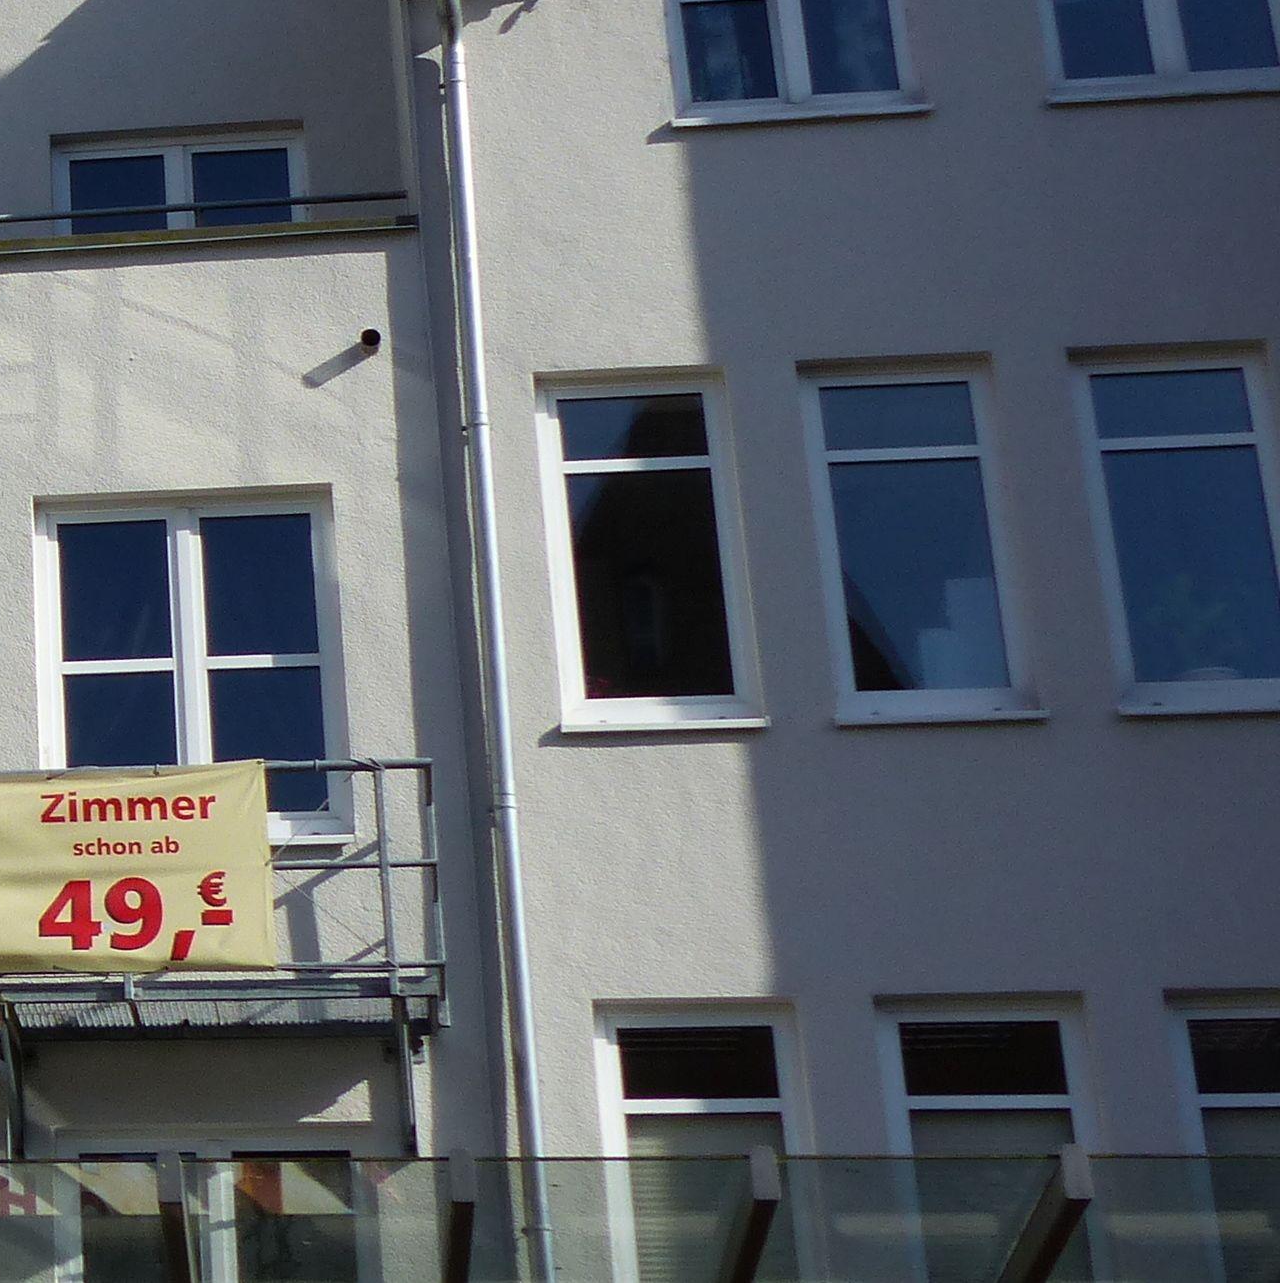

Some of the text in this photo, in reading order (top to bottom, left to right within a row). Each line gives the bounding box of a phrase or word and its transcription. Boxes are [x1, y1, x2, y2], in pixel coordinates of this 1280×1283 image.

[40, 791, 216, 824] Zimmer
[73, 835, 181, 857] schon ab
